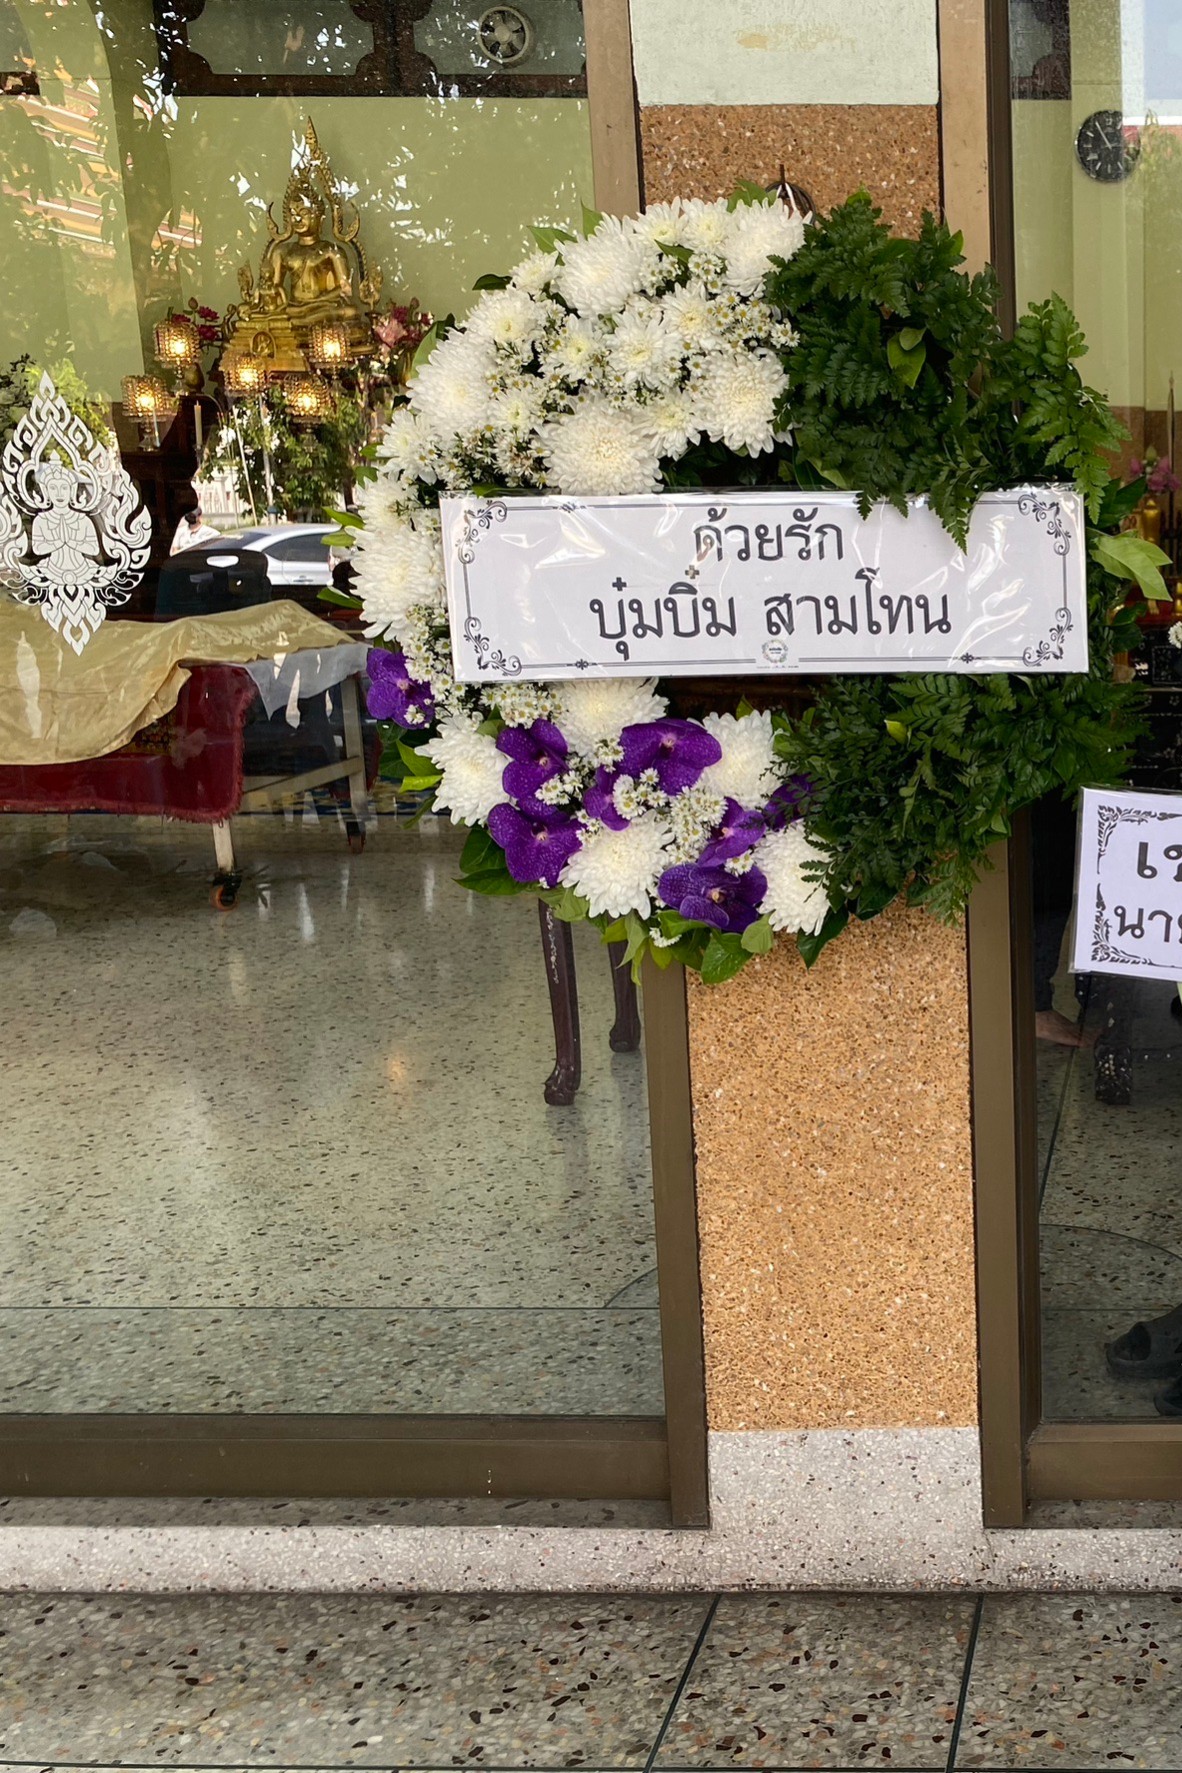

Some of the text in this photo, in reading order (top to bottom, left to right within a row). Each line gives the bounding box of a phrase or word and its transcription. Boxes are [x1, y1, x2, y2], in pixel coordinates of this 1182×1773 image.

[693, 507, 843, 562] ด้วยรัก
[589, 565, 951, 661] บุ๋มบิ๋ม สามโทน
